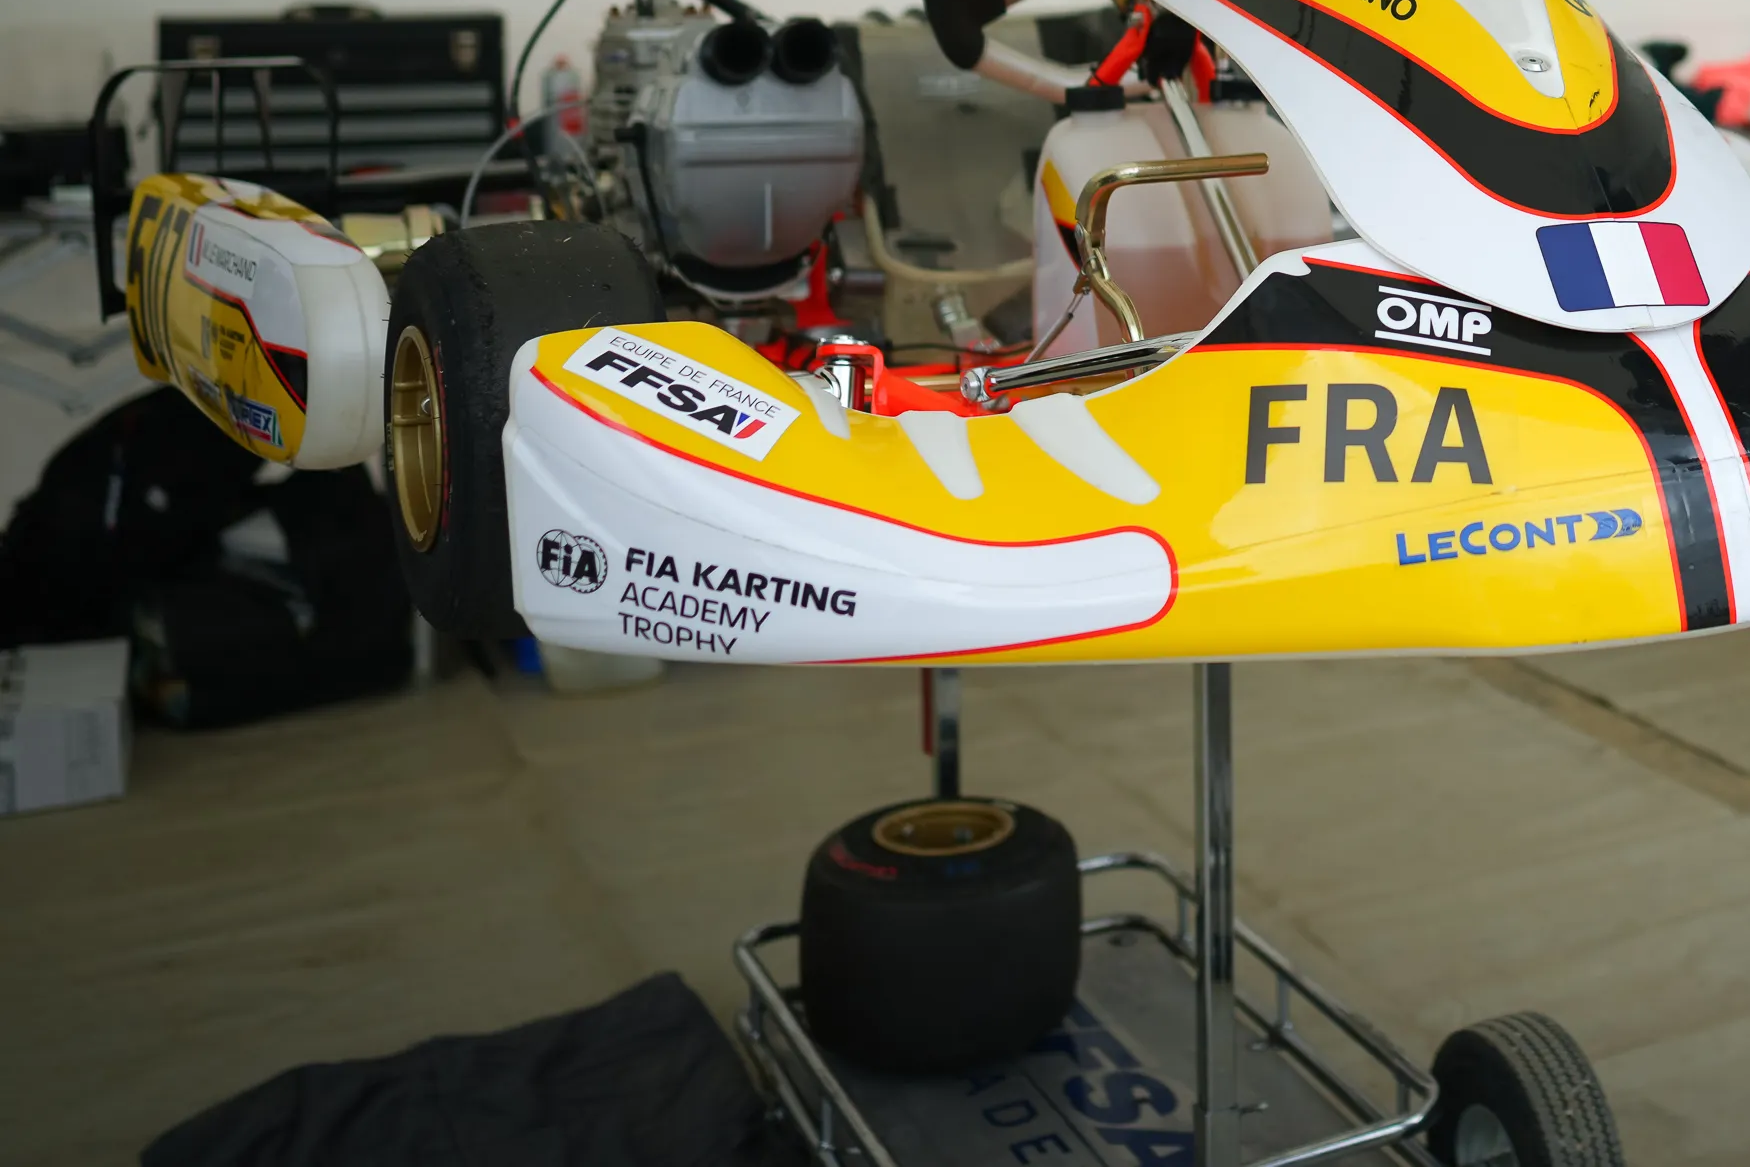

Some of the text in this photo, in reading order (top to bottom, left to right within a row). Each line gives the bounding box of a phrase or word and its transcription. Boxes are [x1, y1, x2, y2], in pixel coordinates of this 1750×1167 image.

[1376, 297, 1492, 345] OMP
[584, 350, 737, 435] FFSA
[609, 336, 782, 419] EQUIPE DE FRANCE
[1244, 383, 1494, 485] FRA
[619, 582, 771, 634] ACADEMY
[624, 547, 858, 618] FIA KARTING
[617, 612, 739, 656] TROPHY
